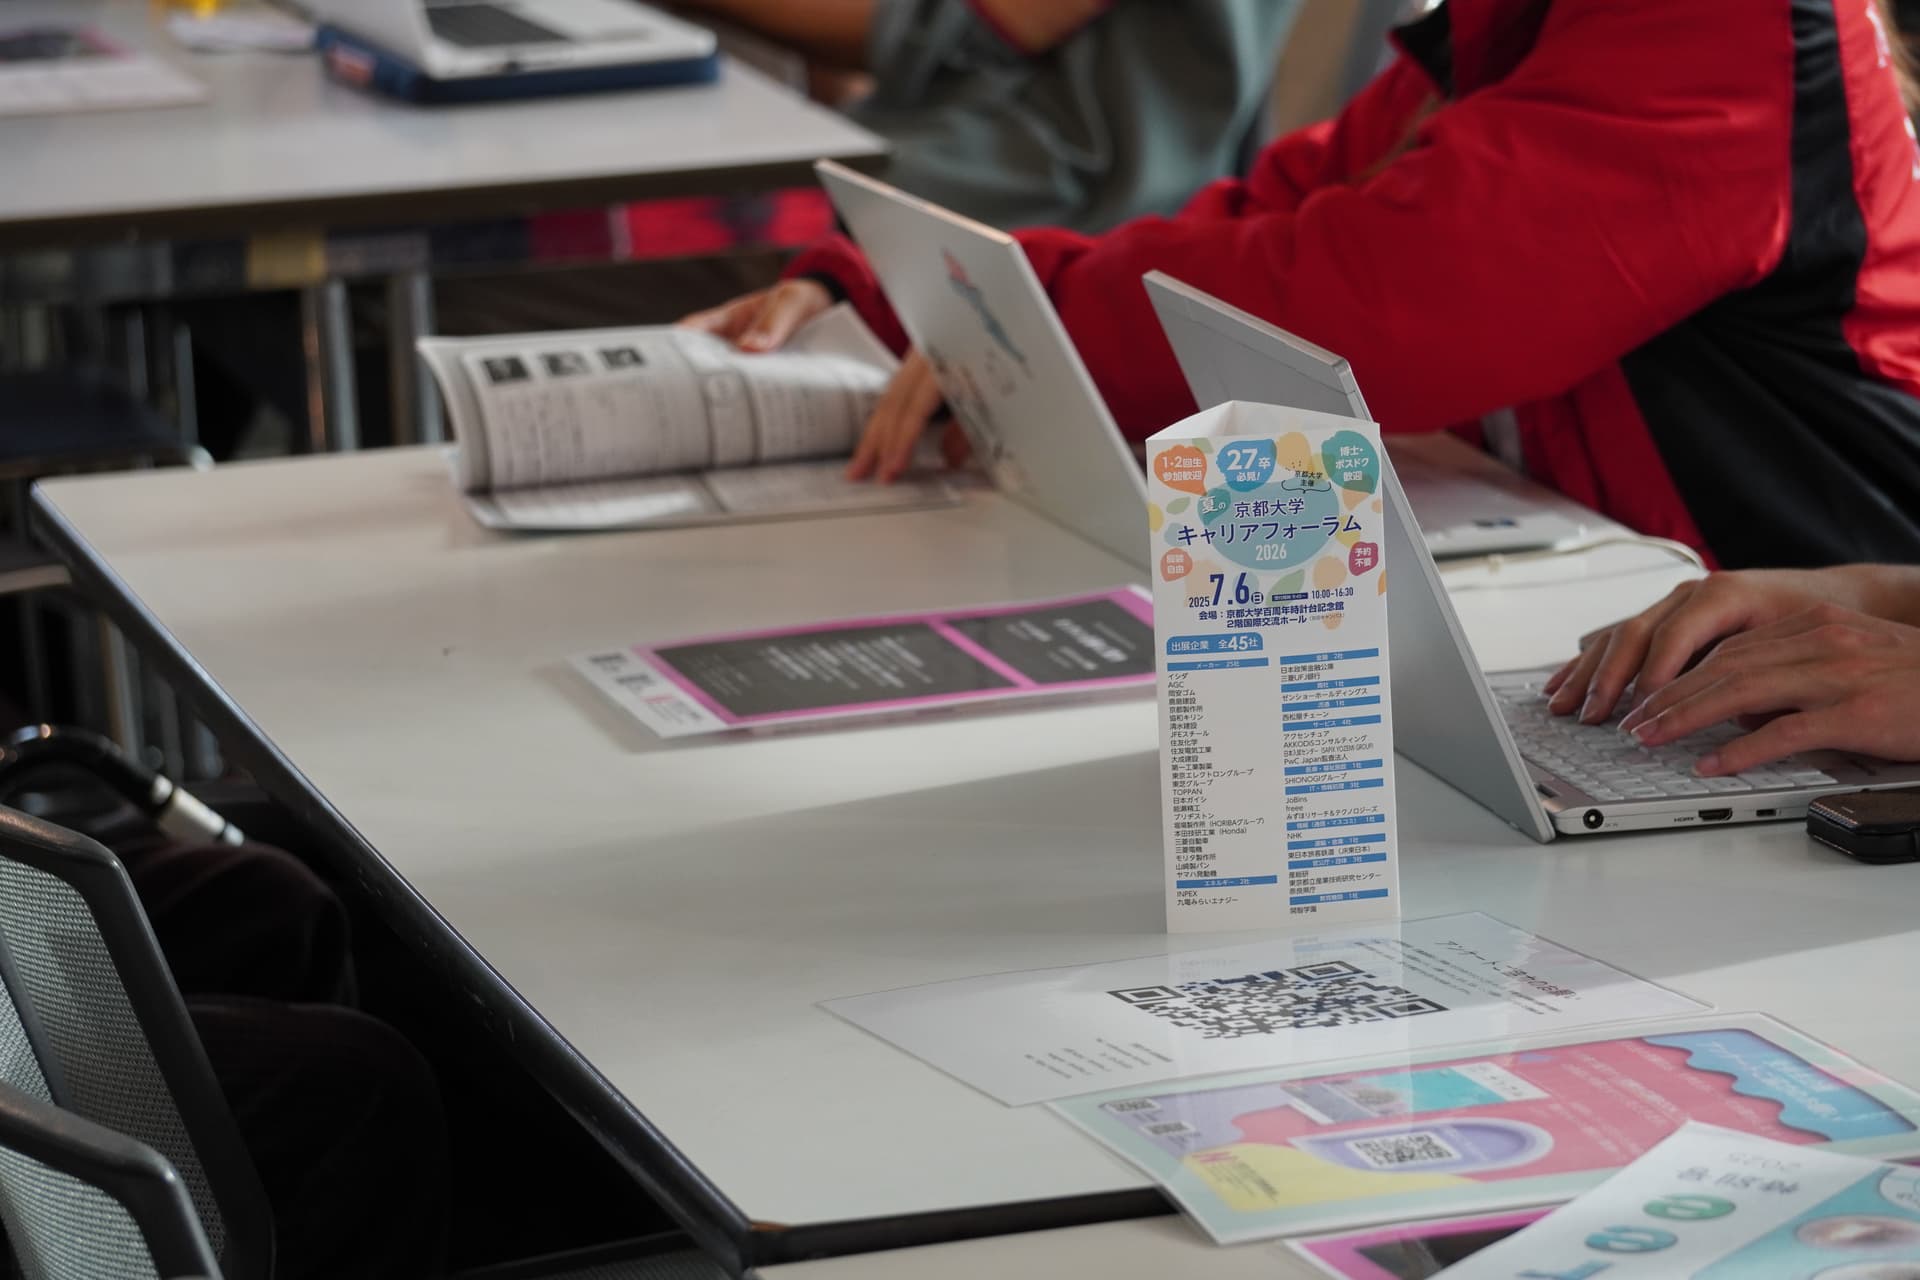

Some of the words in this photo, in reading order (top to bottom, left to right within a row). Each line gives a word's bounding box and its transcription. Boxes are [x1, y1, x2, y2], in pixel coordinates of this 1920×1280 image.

[1227, 448, 1271, 471] 27卒
[1335, 458, 1369, 469] ポスドク
[1234, 498, 1305, 518] 京都大学
[1177, 514, 1362, 546] キャリアフォーラム
[1255, 543, 1287, 561] 2026
[1188, 596, 1210, 608] 2025
[1171, 641, 1209, 652] 出展企業
[1168, 672, 1189, 680] イシダ
[1168, 681, 1184, 689] AGC
[1282, 688, 1368, 701] ゼンショーホールディングス
[1170, 730, 1209, 738] JFEスチール
[1283, 730, 1330, 740] アクセンチュア
[1172, 768, 1255, 780] 東京エレクトロングループ
[1285, 772, 1348, 785] SHIONOGIグループ
[1173, 788, 1203, 796] TOPPAN
[1173, 796, 1207, 805] 日本ガイシ
[1287, 832, 1303, 840] NHK
[1176, 890, 1198, 898] INPEX
